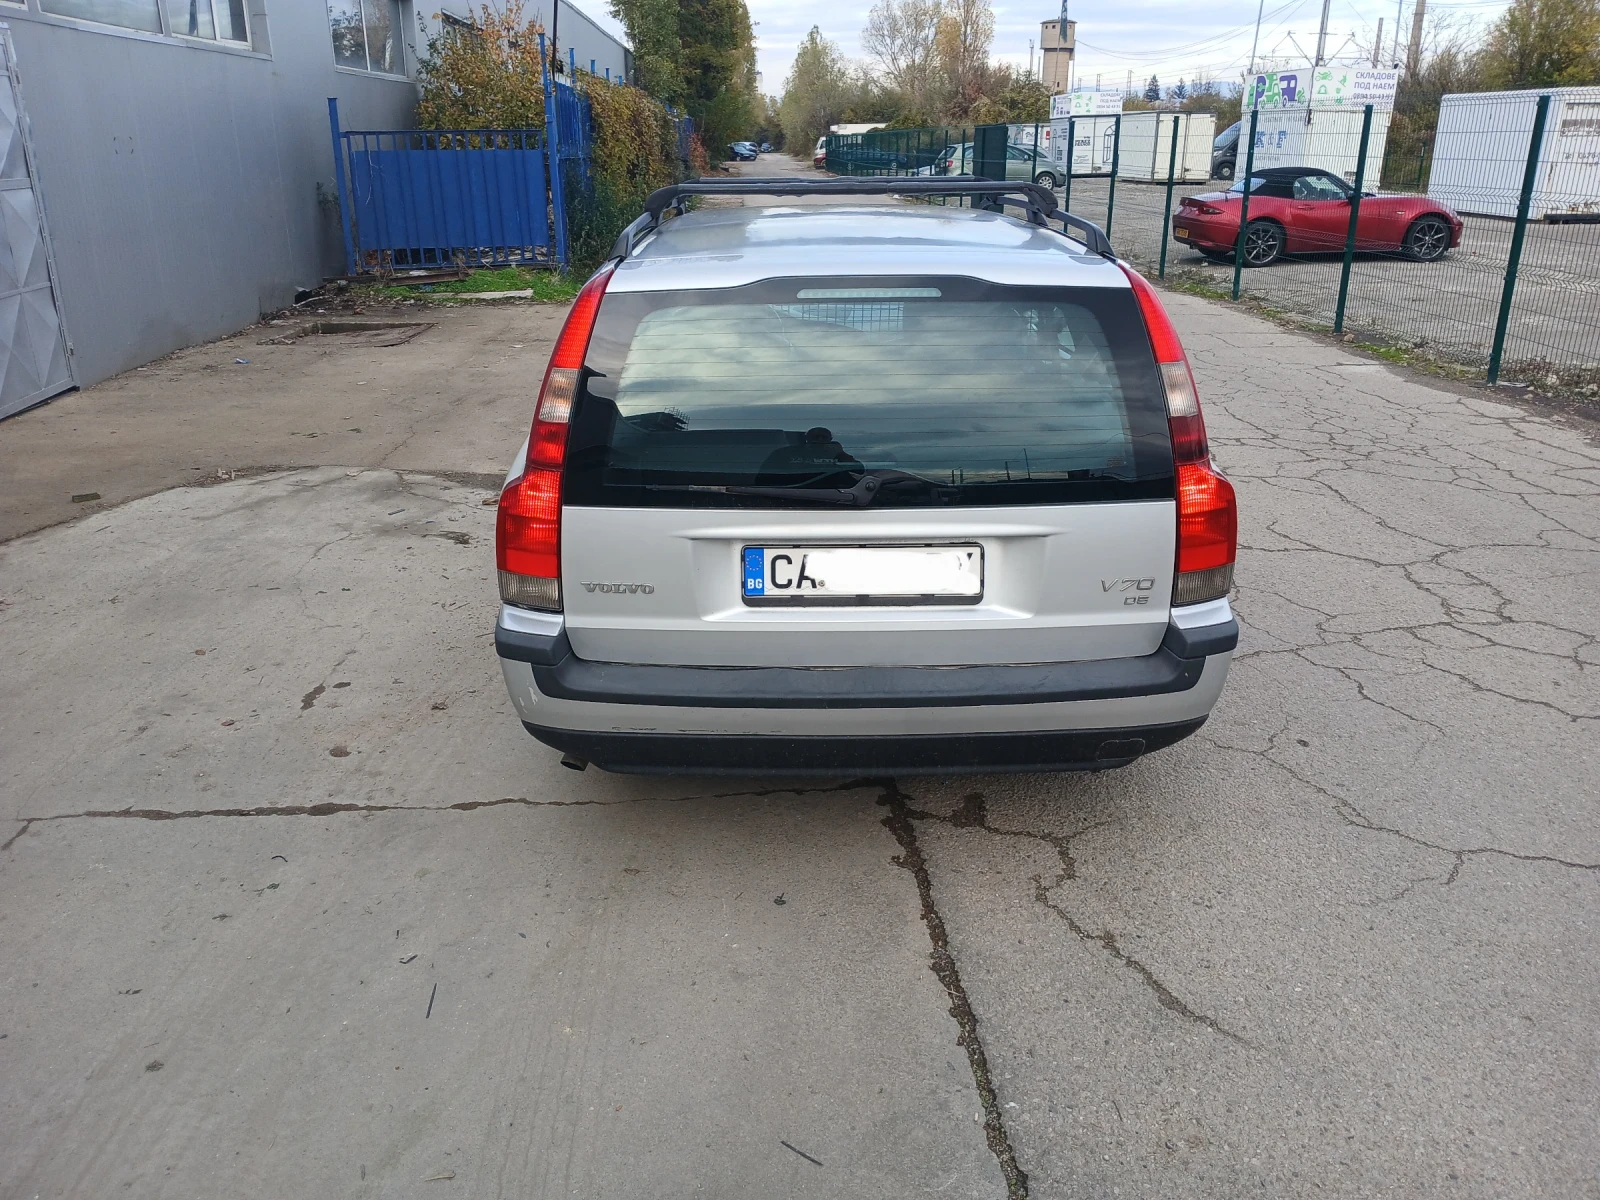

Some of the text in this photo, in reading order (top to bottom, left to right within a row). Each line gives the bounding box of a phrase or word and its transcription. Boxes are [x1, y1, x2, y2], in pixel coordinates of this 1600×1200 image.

[1355, 71, 1396, 80] СКЛАДОВЕ
[1354, 81, 1395, 90] ПОД НАЕМ
[580, 581, 654, 594] VOLVO
[747, 578, 763, 589] BG
[1101, 577, 1155, 592] V70
